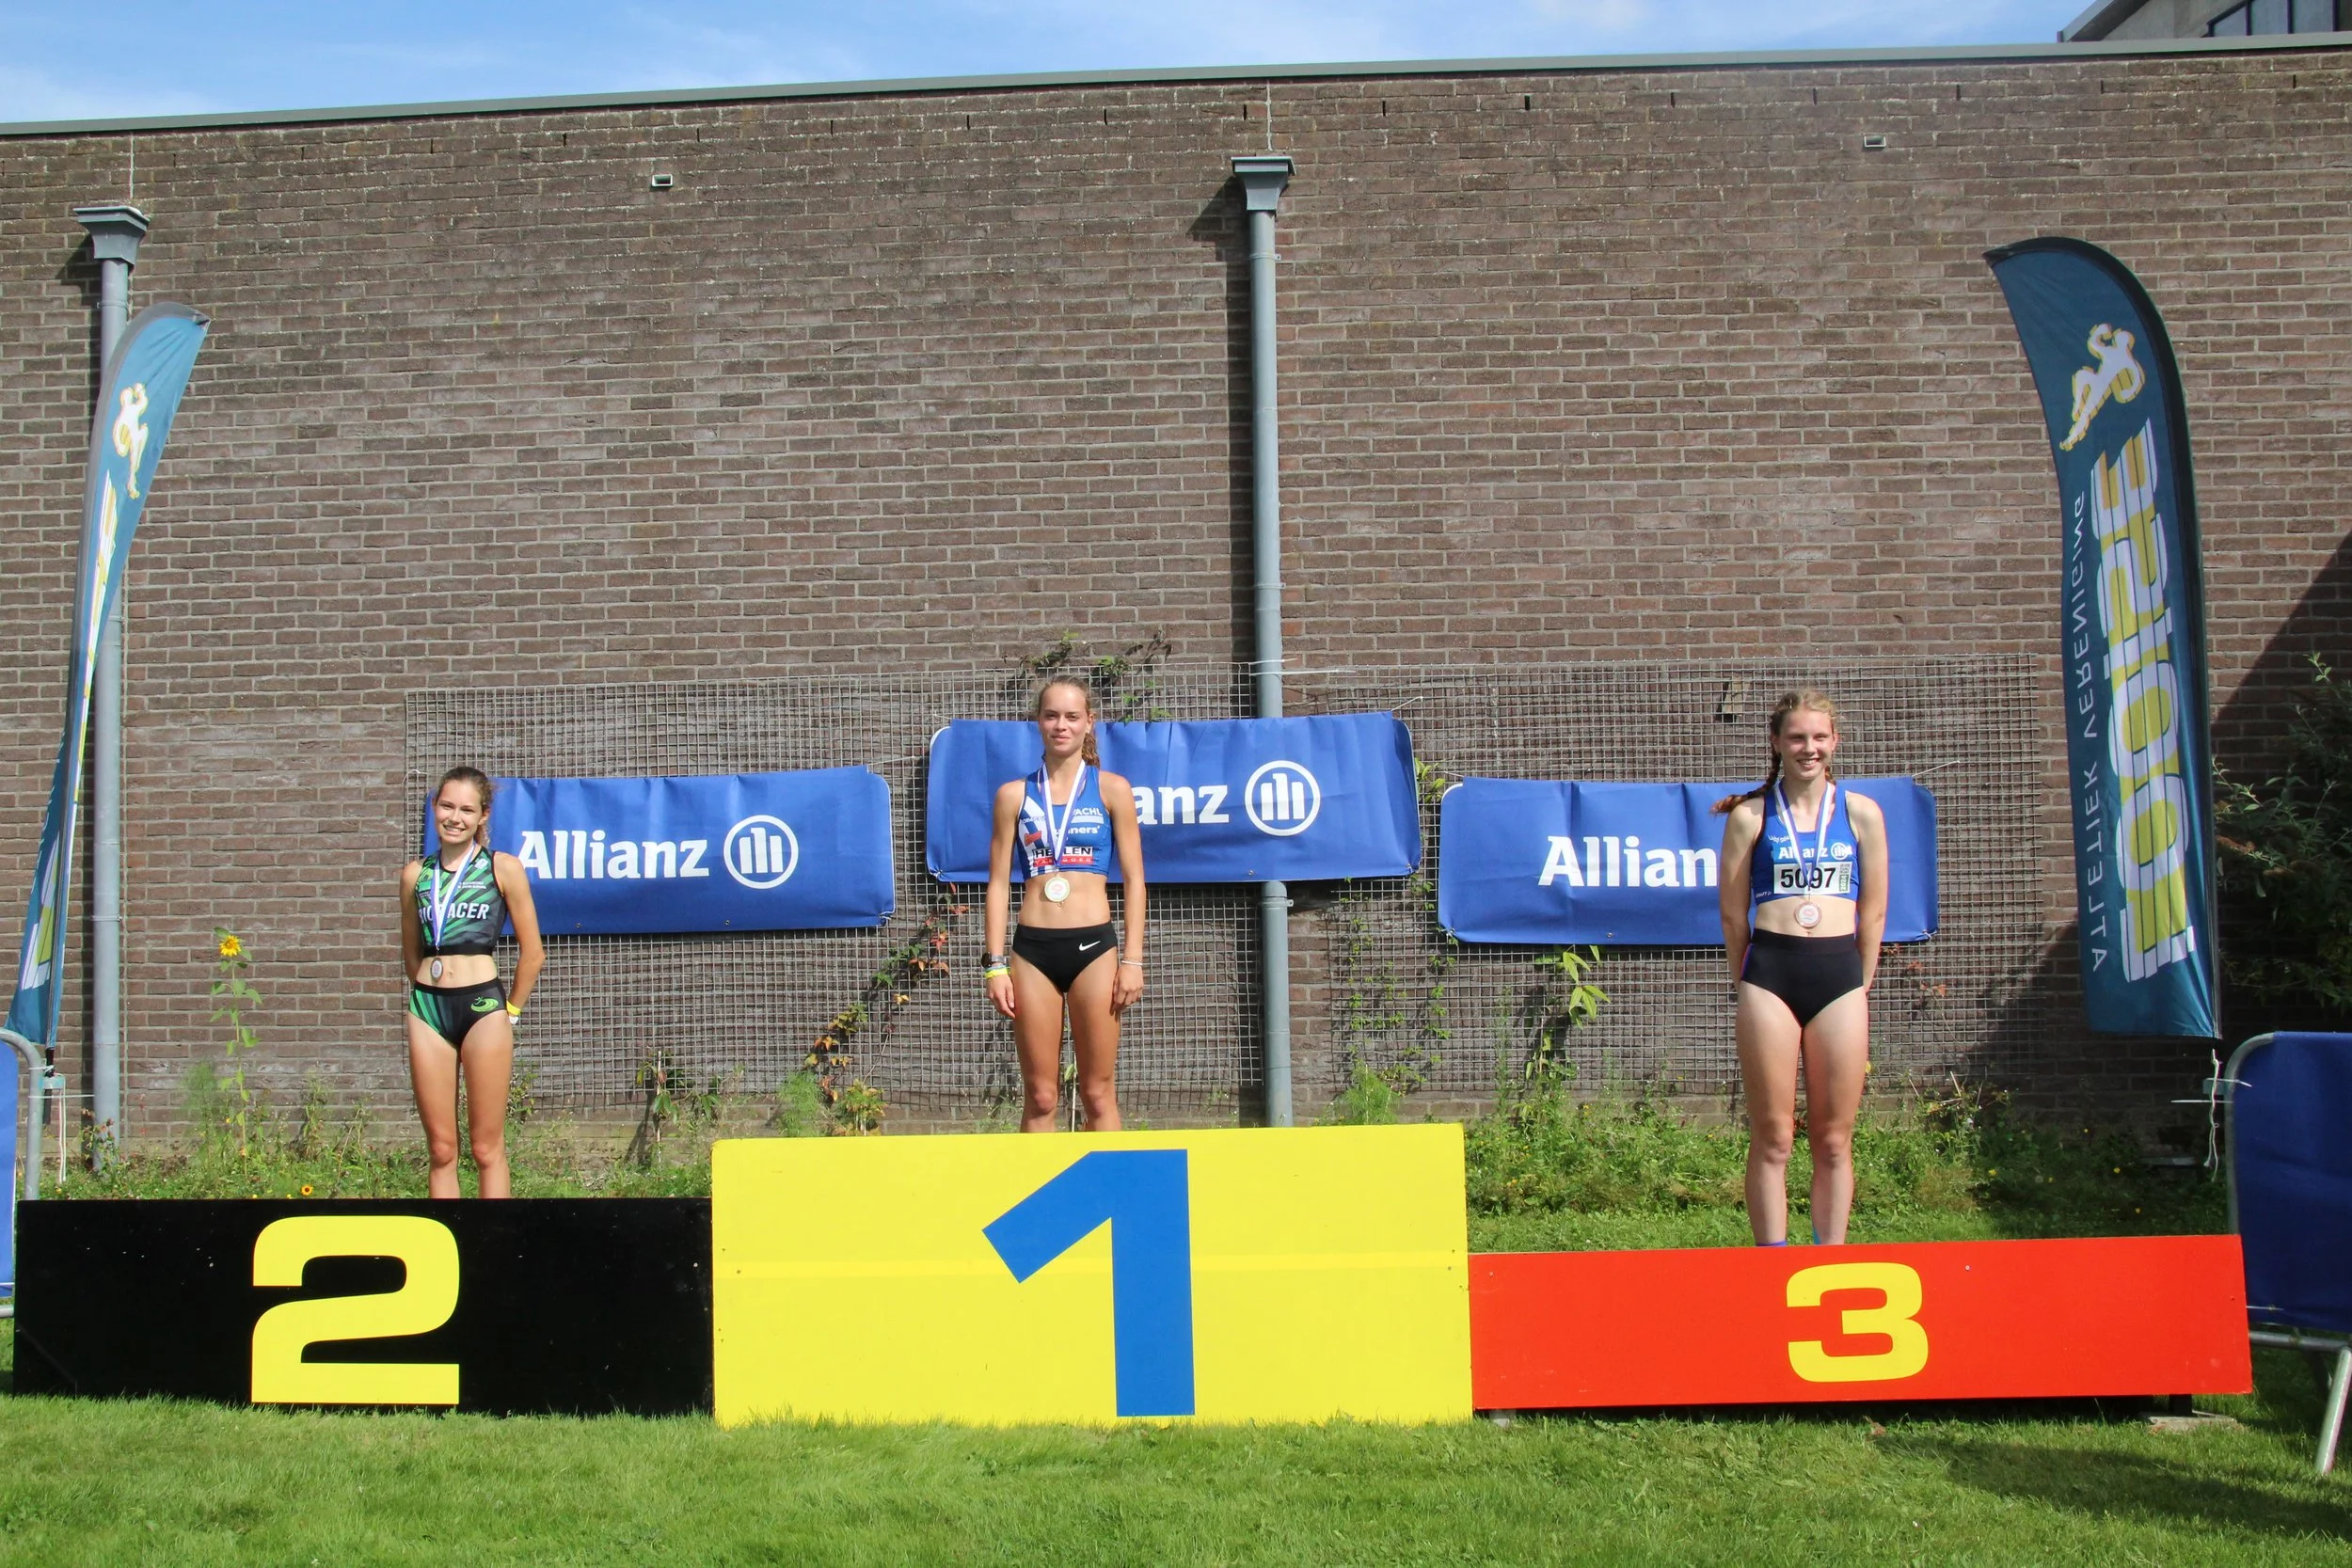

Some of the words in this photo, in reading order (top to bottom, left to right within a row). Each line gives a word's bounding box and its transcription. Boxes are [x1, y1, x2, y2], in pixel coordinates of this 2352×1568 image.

[518, 830, 709, 879] Allianz
[1538, 835, 1717, 888] Allian
[1780, 867, 1836, 889] 5097
[251, 1215, 459, 1404] 2
[981, 1148, 1195, 1416] 1
[1786, 1262, 1928, 1382] 3
